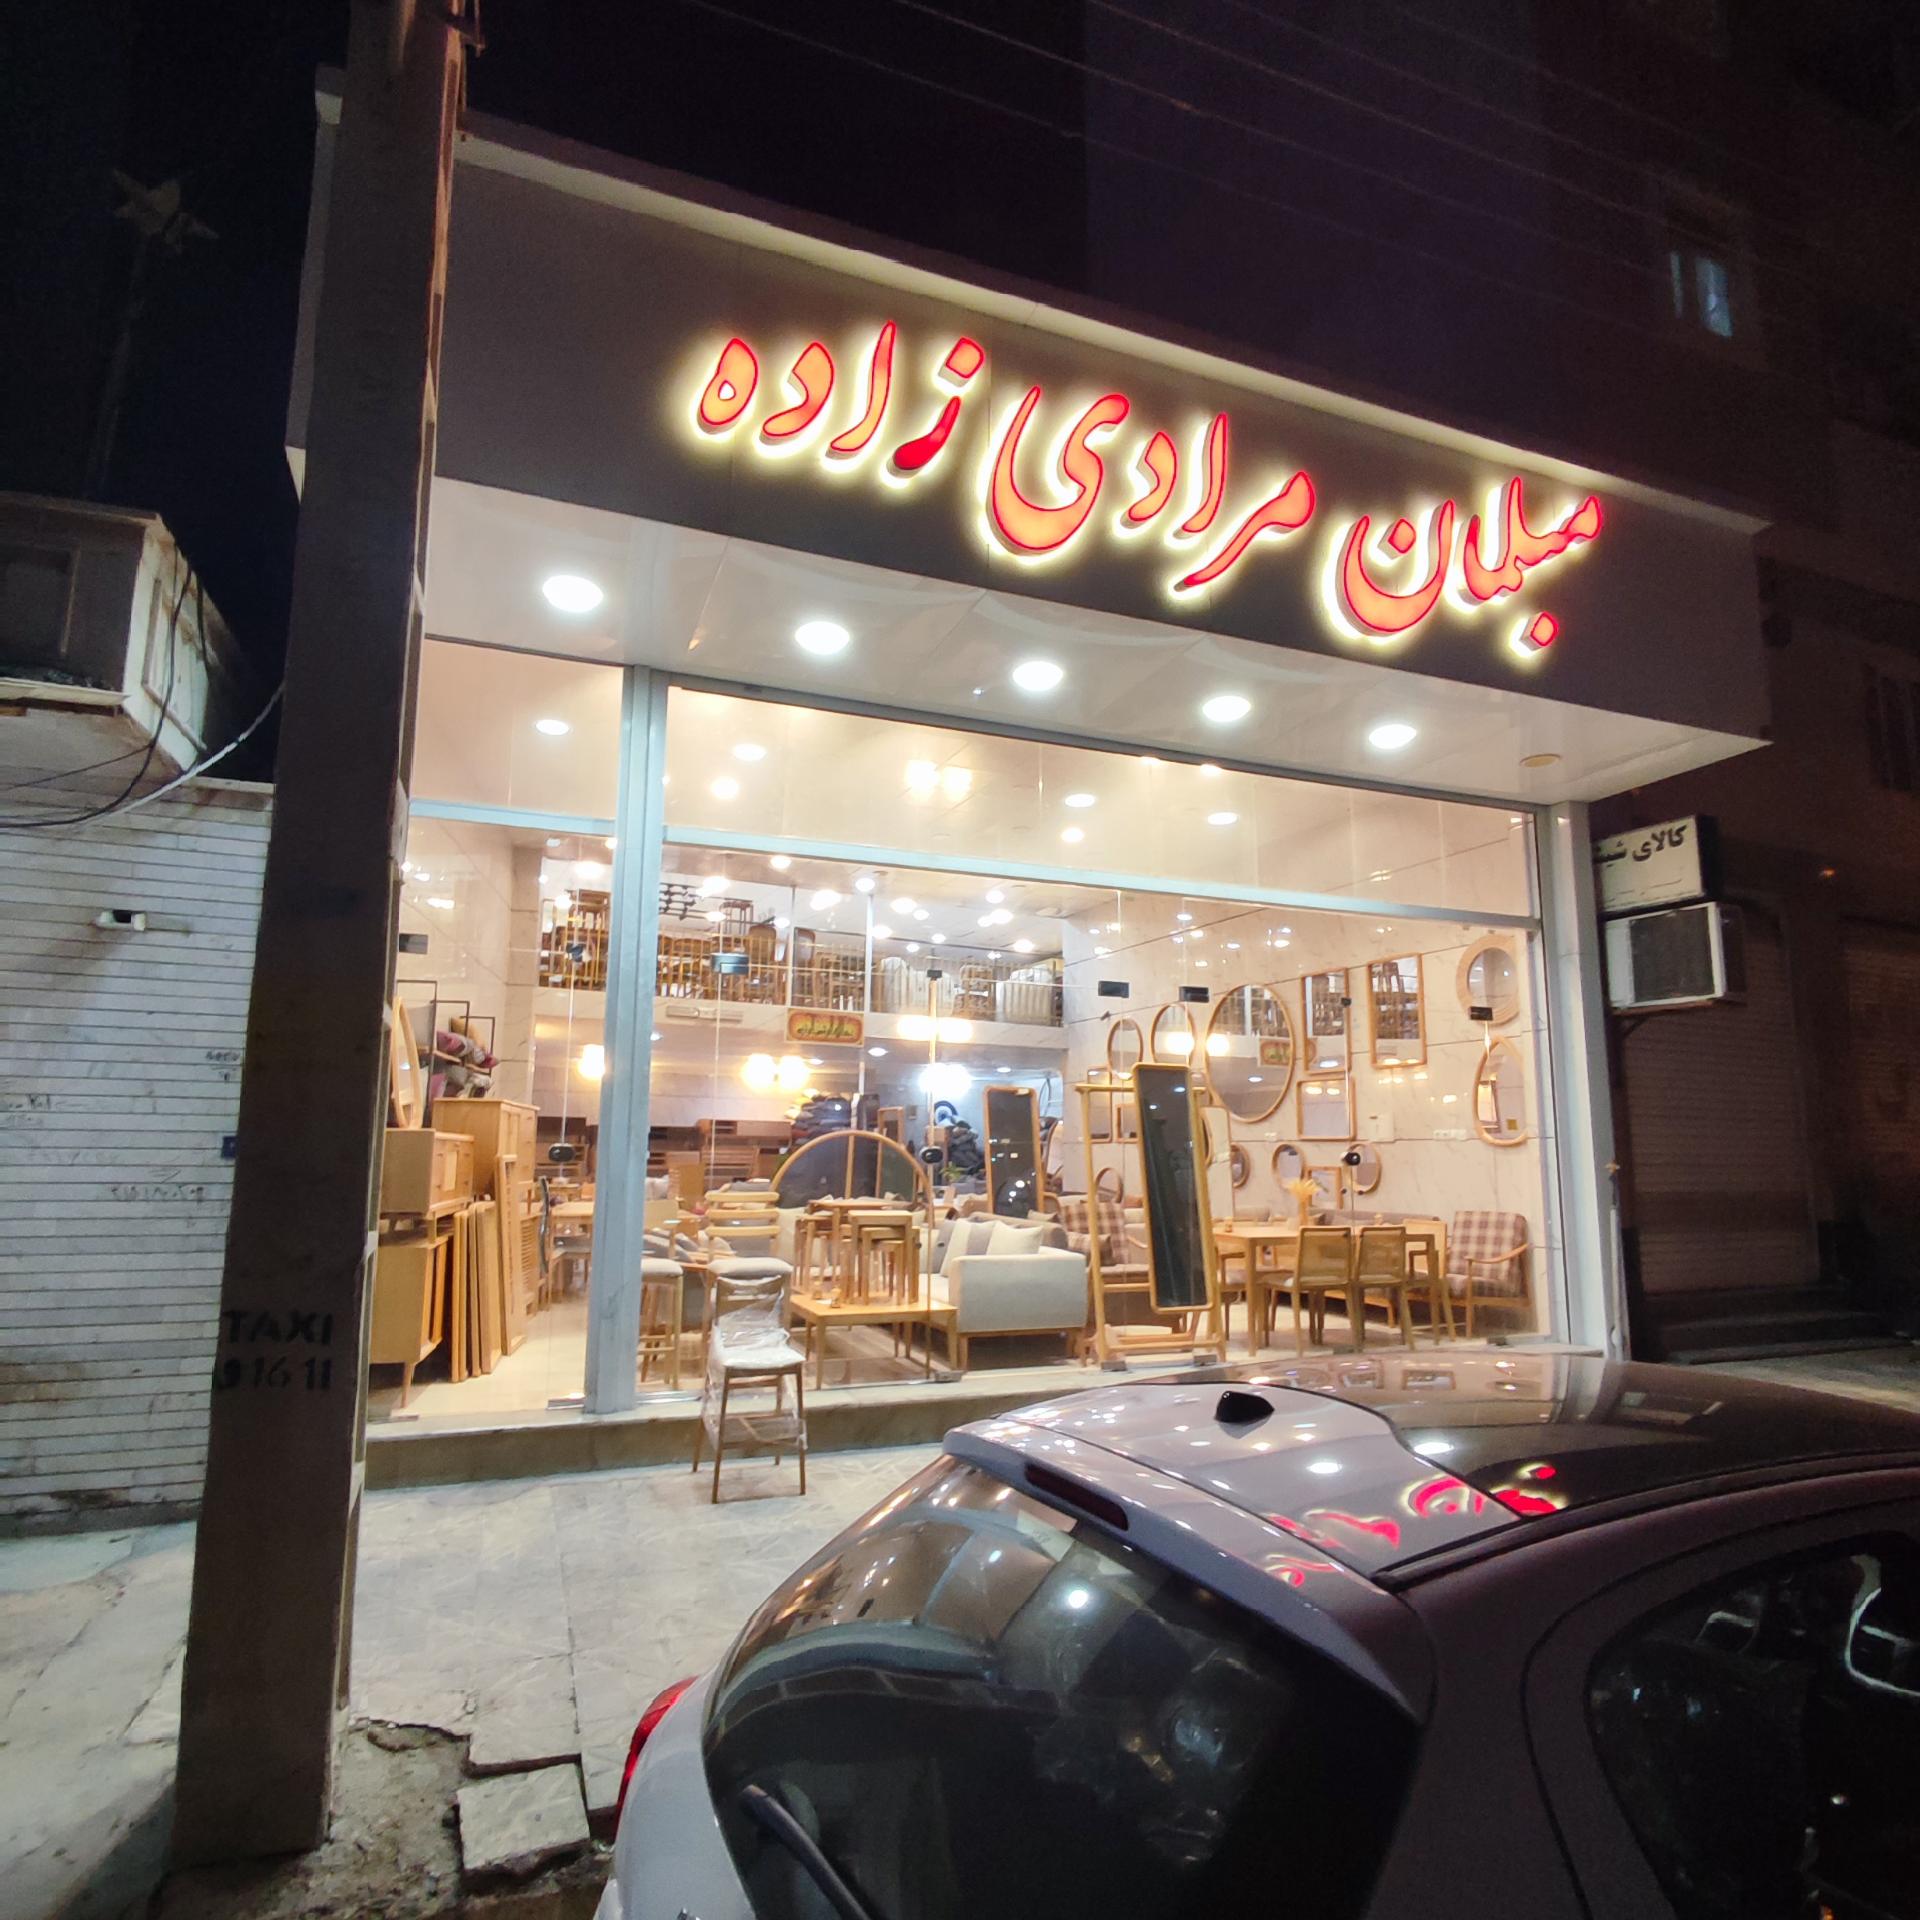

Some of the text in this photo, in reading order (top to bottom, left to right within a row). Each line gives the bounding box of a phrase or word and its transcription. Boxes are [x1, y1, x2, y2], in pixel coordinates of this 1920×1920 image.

[699, 319, 986, 473] زاده
[991, 386, 1316, 592] مرادی
[1632, 824, 1687, 863] کالای
[221, 1309, 333, 1345] TAXI
